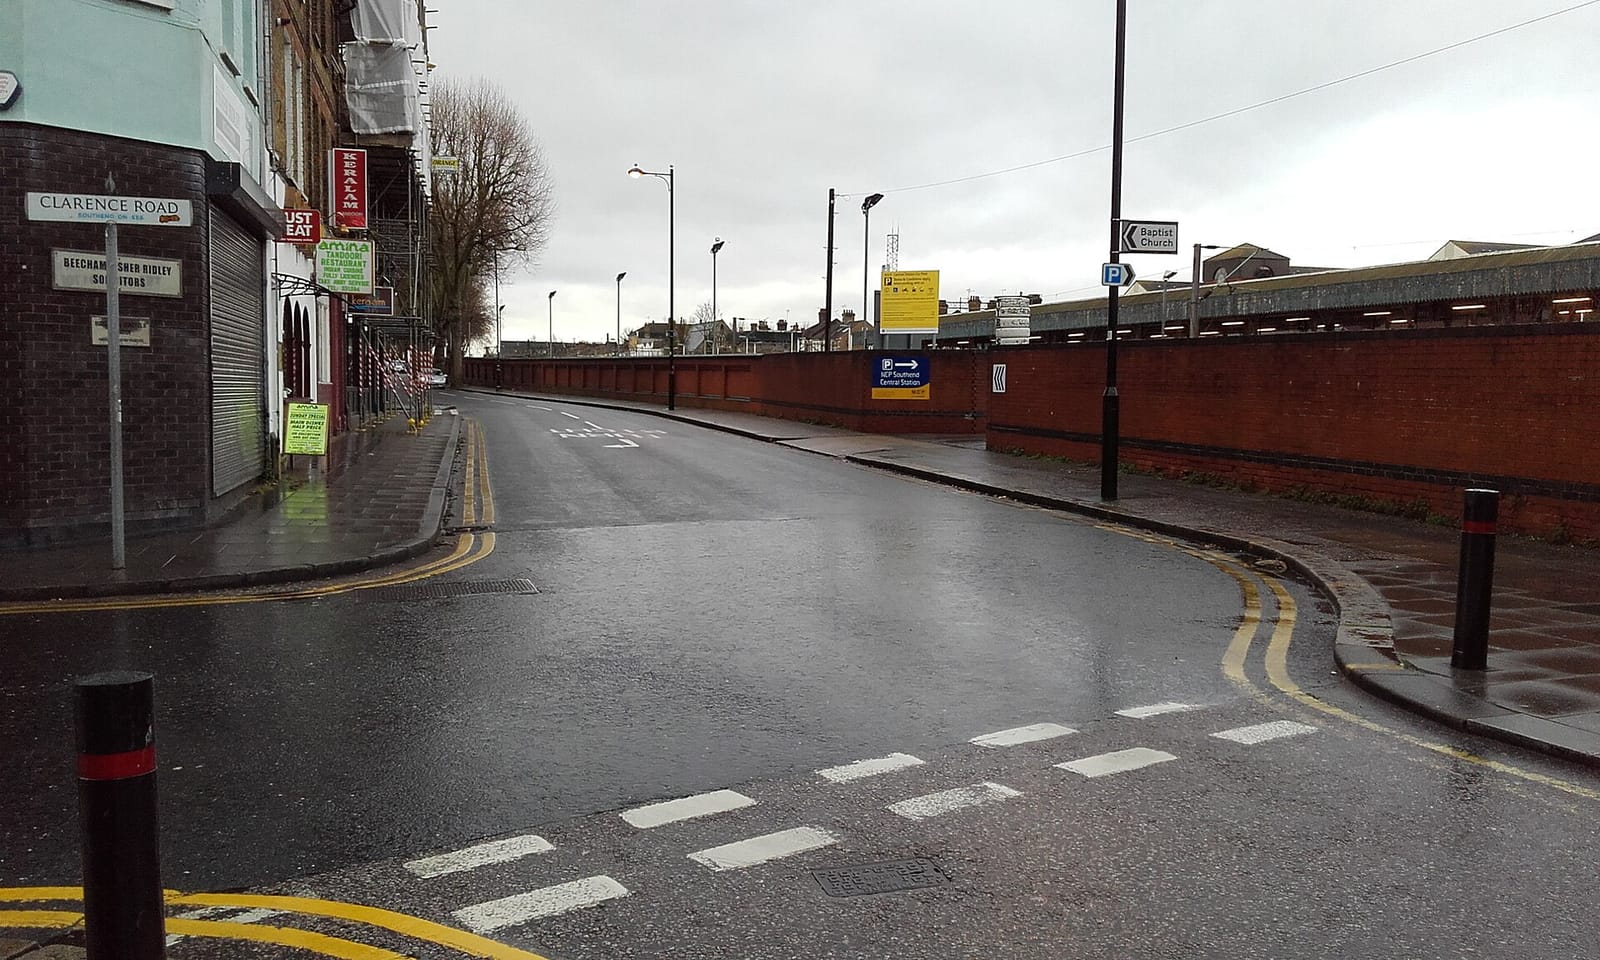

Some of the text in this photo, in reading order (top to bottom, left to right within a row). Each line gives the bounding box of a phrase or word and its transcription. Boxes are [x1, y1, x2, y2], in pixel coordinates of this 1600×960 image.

[342, 152, 358, 208] KERALAM
[40, 195, 179, 214] CLARENCE ROAD
[284, 212, 312, 224] UST
[286, 224, 313, 236] EAT
[1140, 228, 1173, 237] Baptist
[1140, 238, 1174, 246] Church
[326, 251, 362, 260] TANDOORI
[117, 262, 140, 274] SHER
[142, 264, 172, 276] RIDLEY
[320, 258, 366, 268] RESTAURANT
[92, 274, 146, 288] SOITORS
